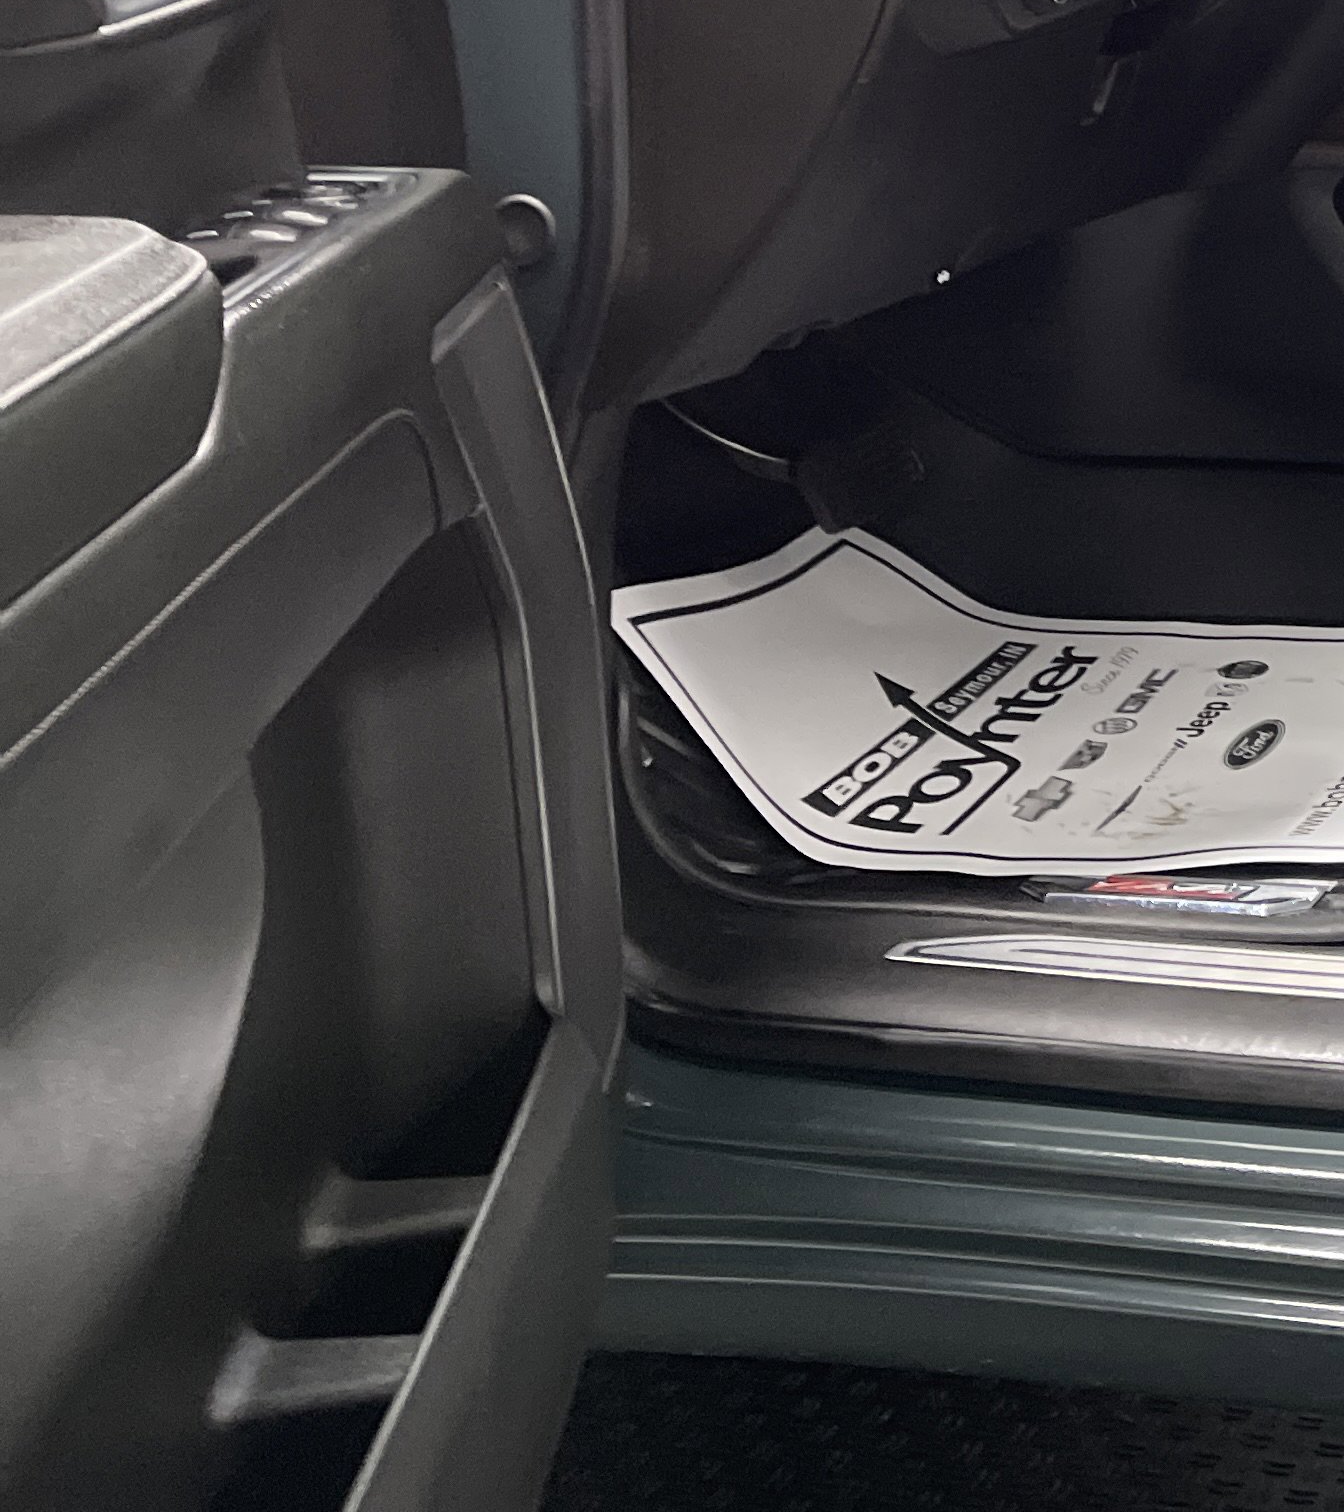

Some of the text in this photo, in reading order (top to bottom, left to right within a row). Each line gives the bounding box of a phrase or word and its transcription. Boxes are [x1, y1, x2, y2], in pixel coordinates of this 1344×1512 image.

[1115, 668, 1180, 714] GMC
[849, 645, 1099, 835] Poynter
[1176, 699, 1232, 738] Jeep
[1231, 730, 1274, 760] Ford
[822, 731, 920, 806] BOB
